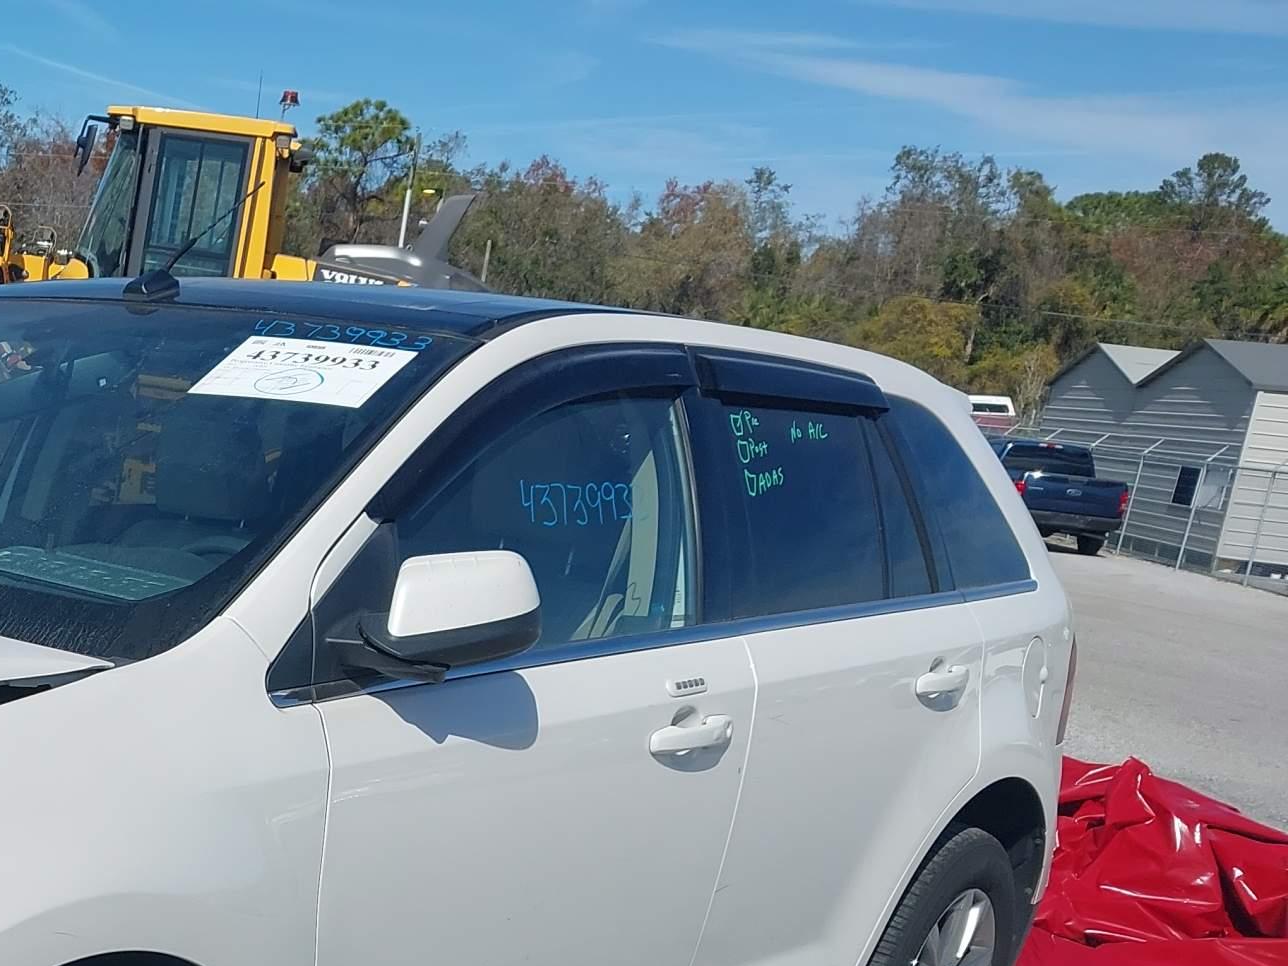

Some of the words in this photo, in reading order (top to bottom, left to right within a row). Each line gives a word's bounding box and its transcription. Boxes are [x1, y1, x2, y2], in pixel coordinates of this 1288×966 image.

[255, 319, 433, 350] 43739933
[247, 350, 380, 371] 43739933
[749, 438, 768, 458] Post
[758, 466, 784, 494] ADAS
